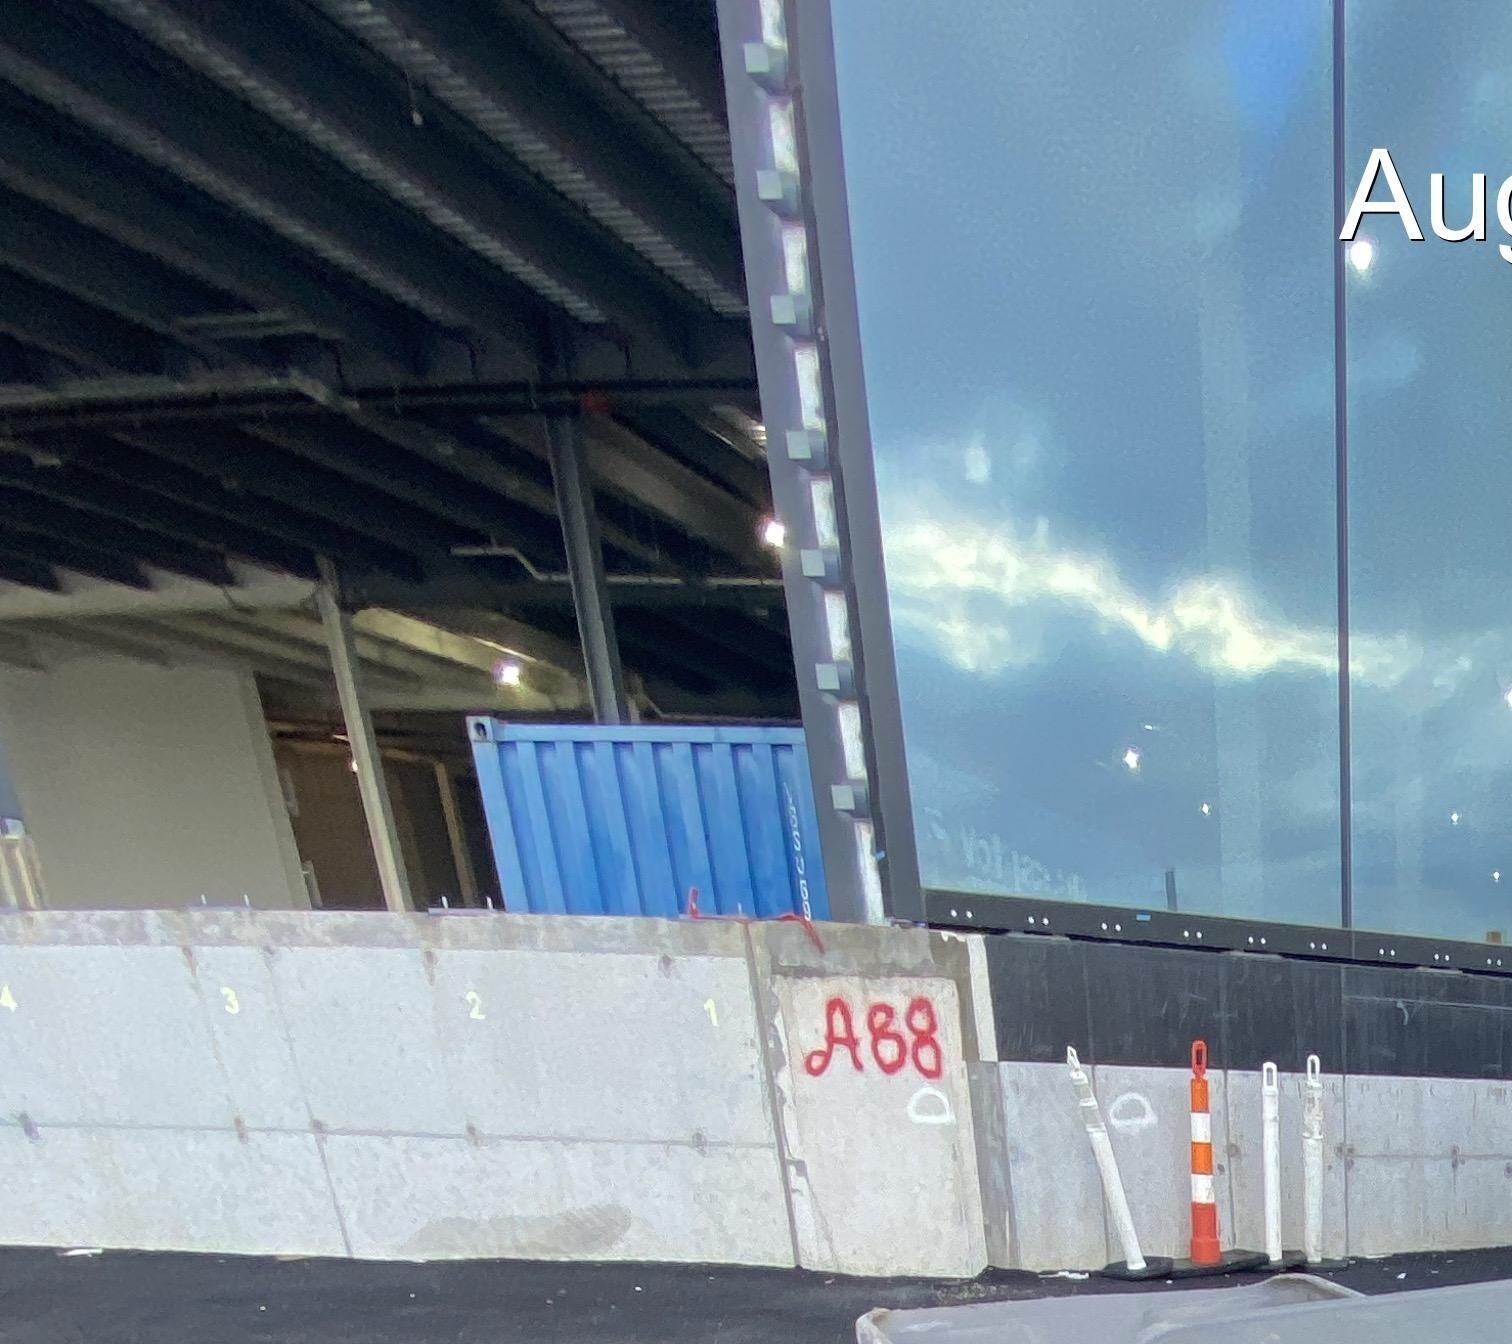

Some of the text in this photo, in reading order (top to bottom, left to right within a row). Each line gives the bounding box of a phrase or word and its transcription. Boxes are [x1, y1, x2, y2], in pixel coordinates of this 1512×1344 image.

[220, 987, 240, 1015] 3
[466, 991, 486, 1019] 2
[704, 999, 719, 1027] 1
